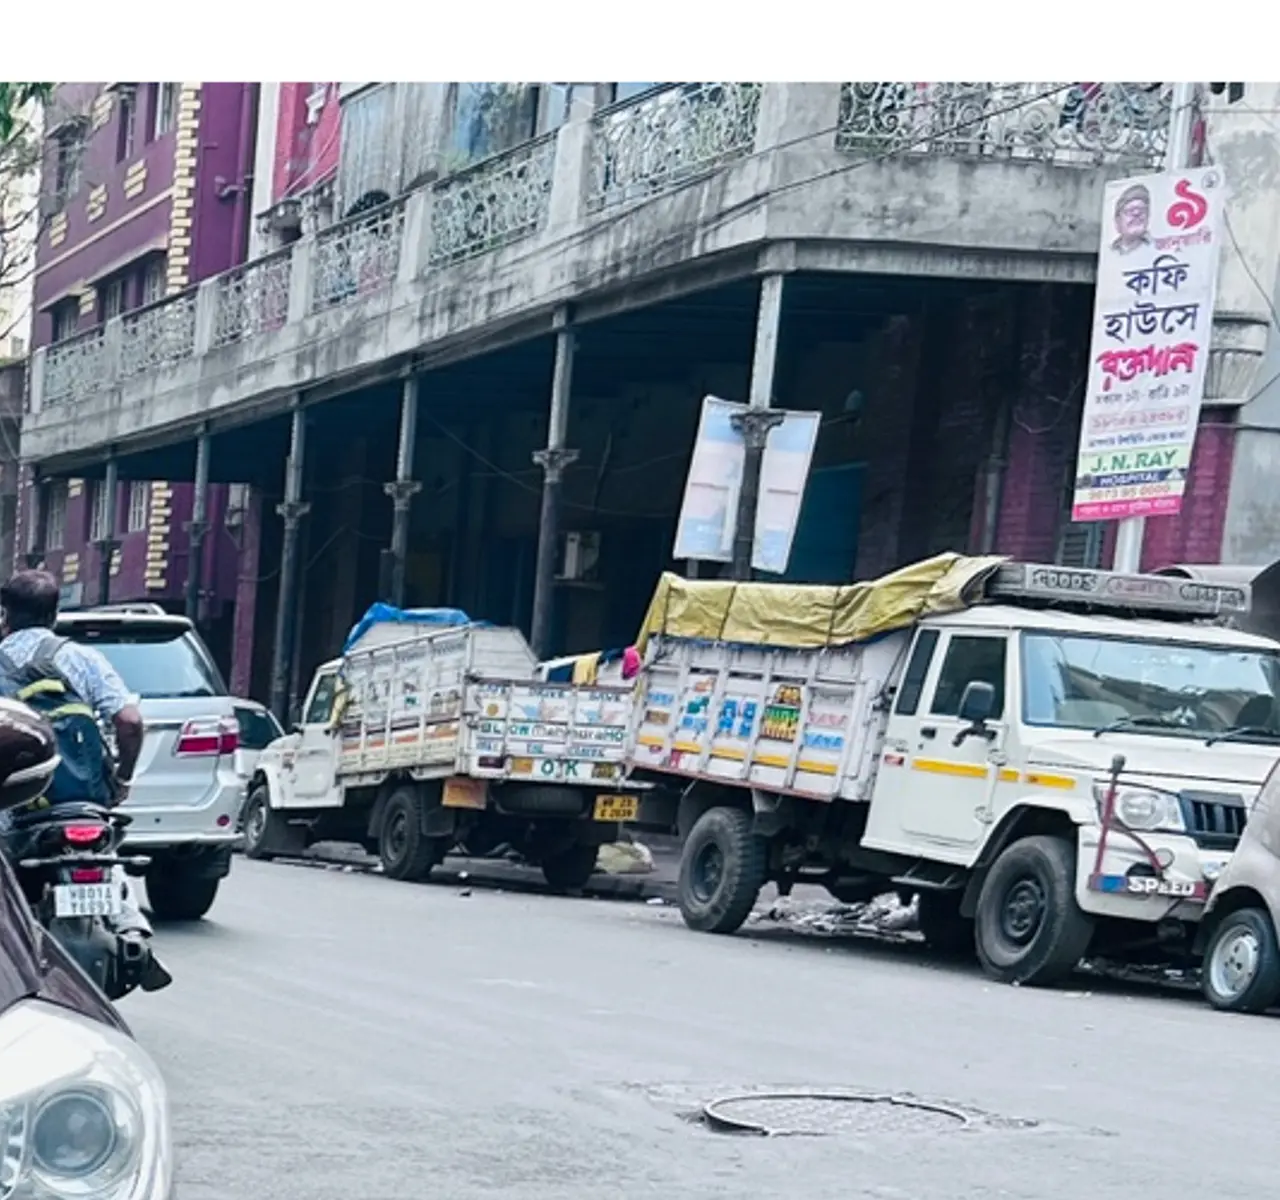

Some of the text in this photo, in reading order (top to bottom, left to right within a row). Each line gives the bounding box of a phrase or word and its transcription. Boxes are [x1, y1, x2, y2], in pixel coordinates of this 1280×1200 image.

[1167, 178, 1208, 229] ৯
[1124, 254, 1191, 296] কফি
[1103, 303, 1200, 343] হাউসে
[1096, 343, 1199, 392] রক্তদান
[1135, 449, 1178, 468] RAY
[1128, 875, 1196, 896] SPEED
